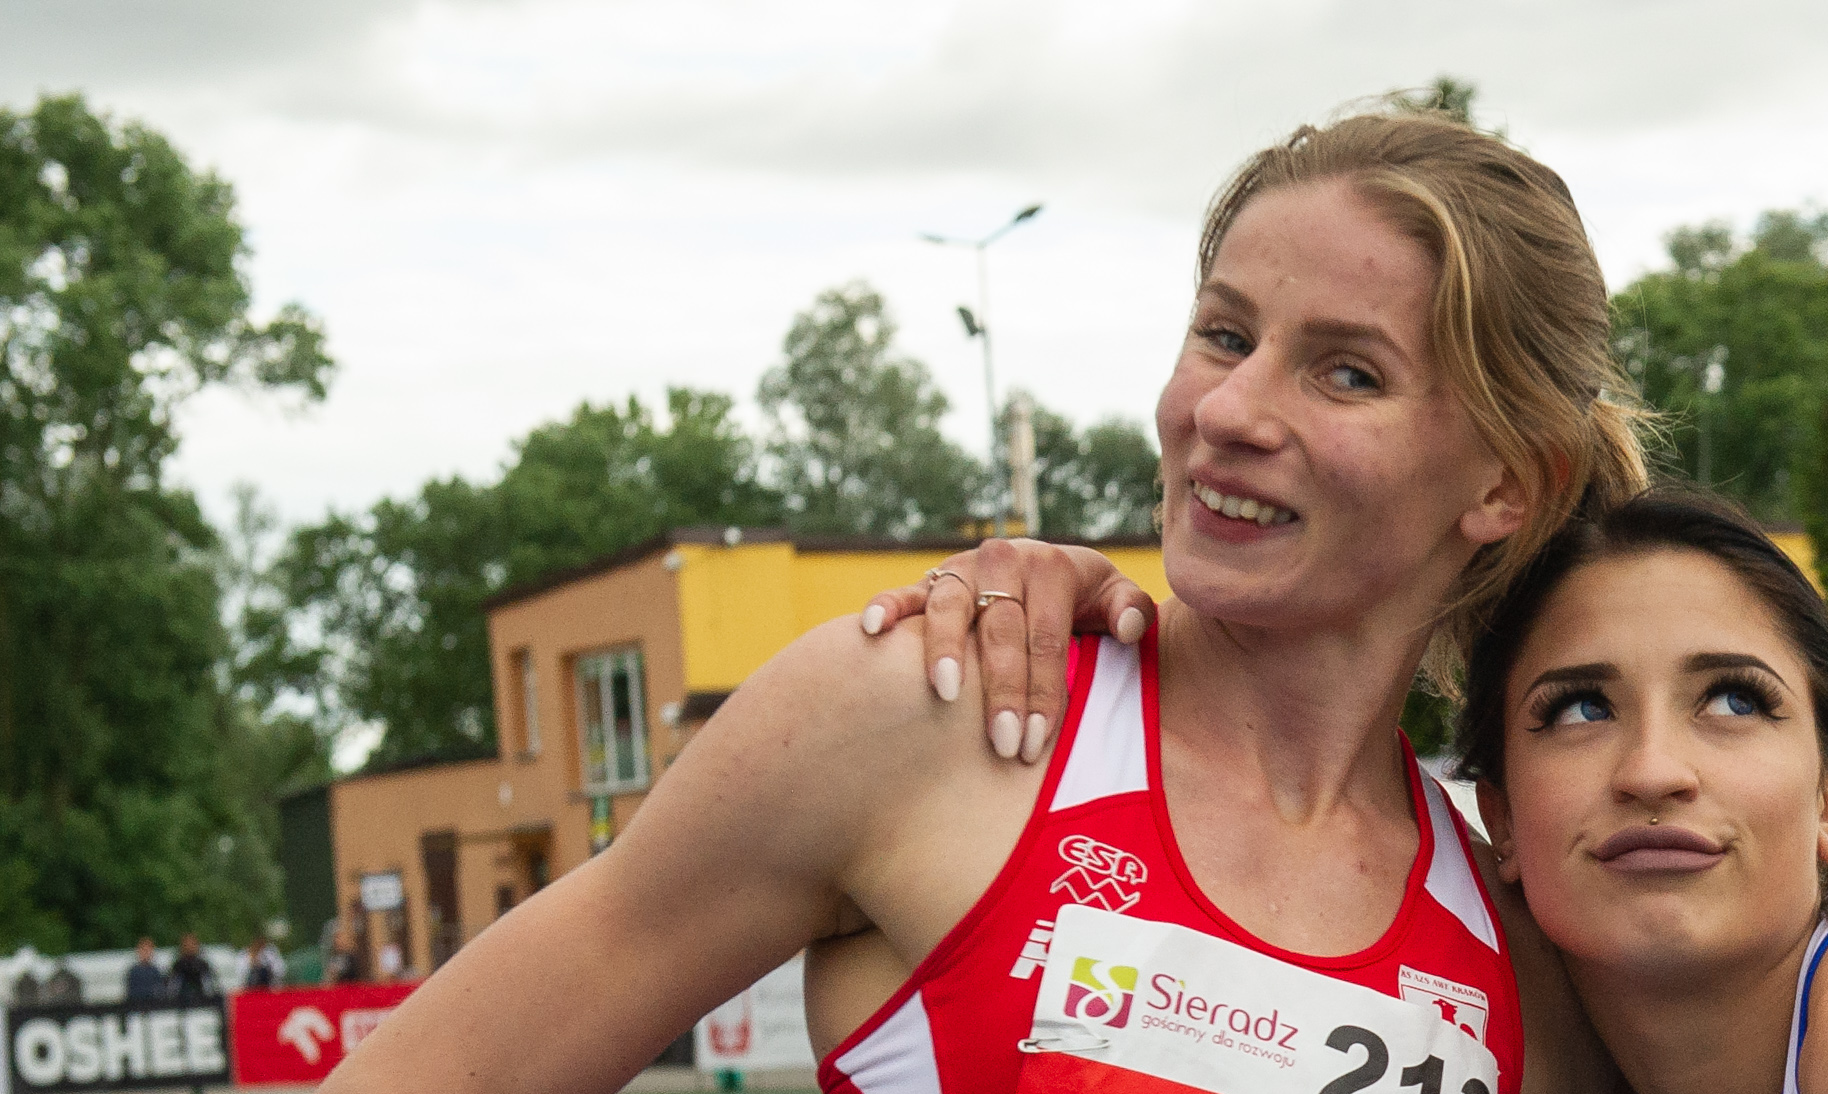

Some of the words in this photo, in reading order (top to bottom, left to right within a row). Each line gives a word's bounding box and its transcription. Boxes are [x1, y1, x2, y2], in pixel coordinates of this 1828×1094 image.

[14, 1006, 227, 1086] OSHEE
[1141, 1013, 1206, 1044] gościnny
[1212, 1029, 1235, 1049] dla
[1238, 1041, 1296, 1070] rozwoju
[1147, 973, 1299, 1051] Sieradz
